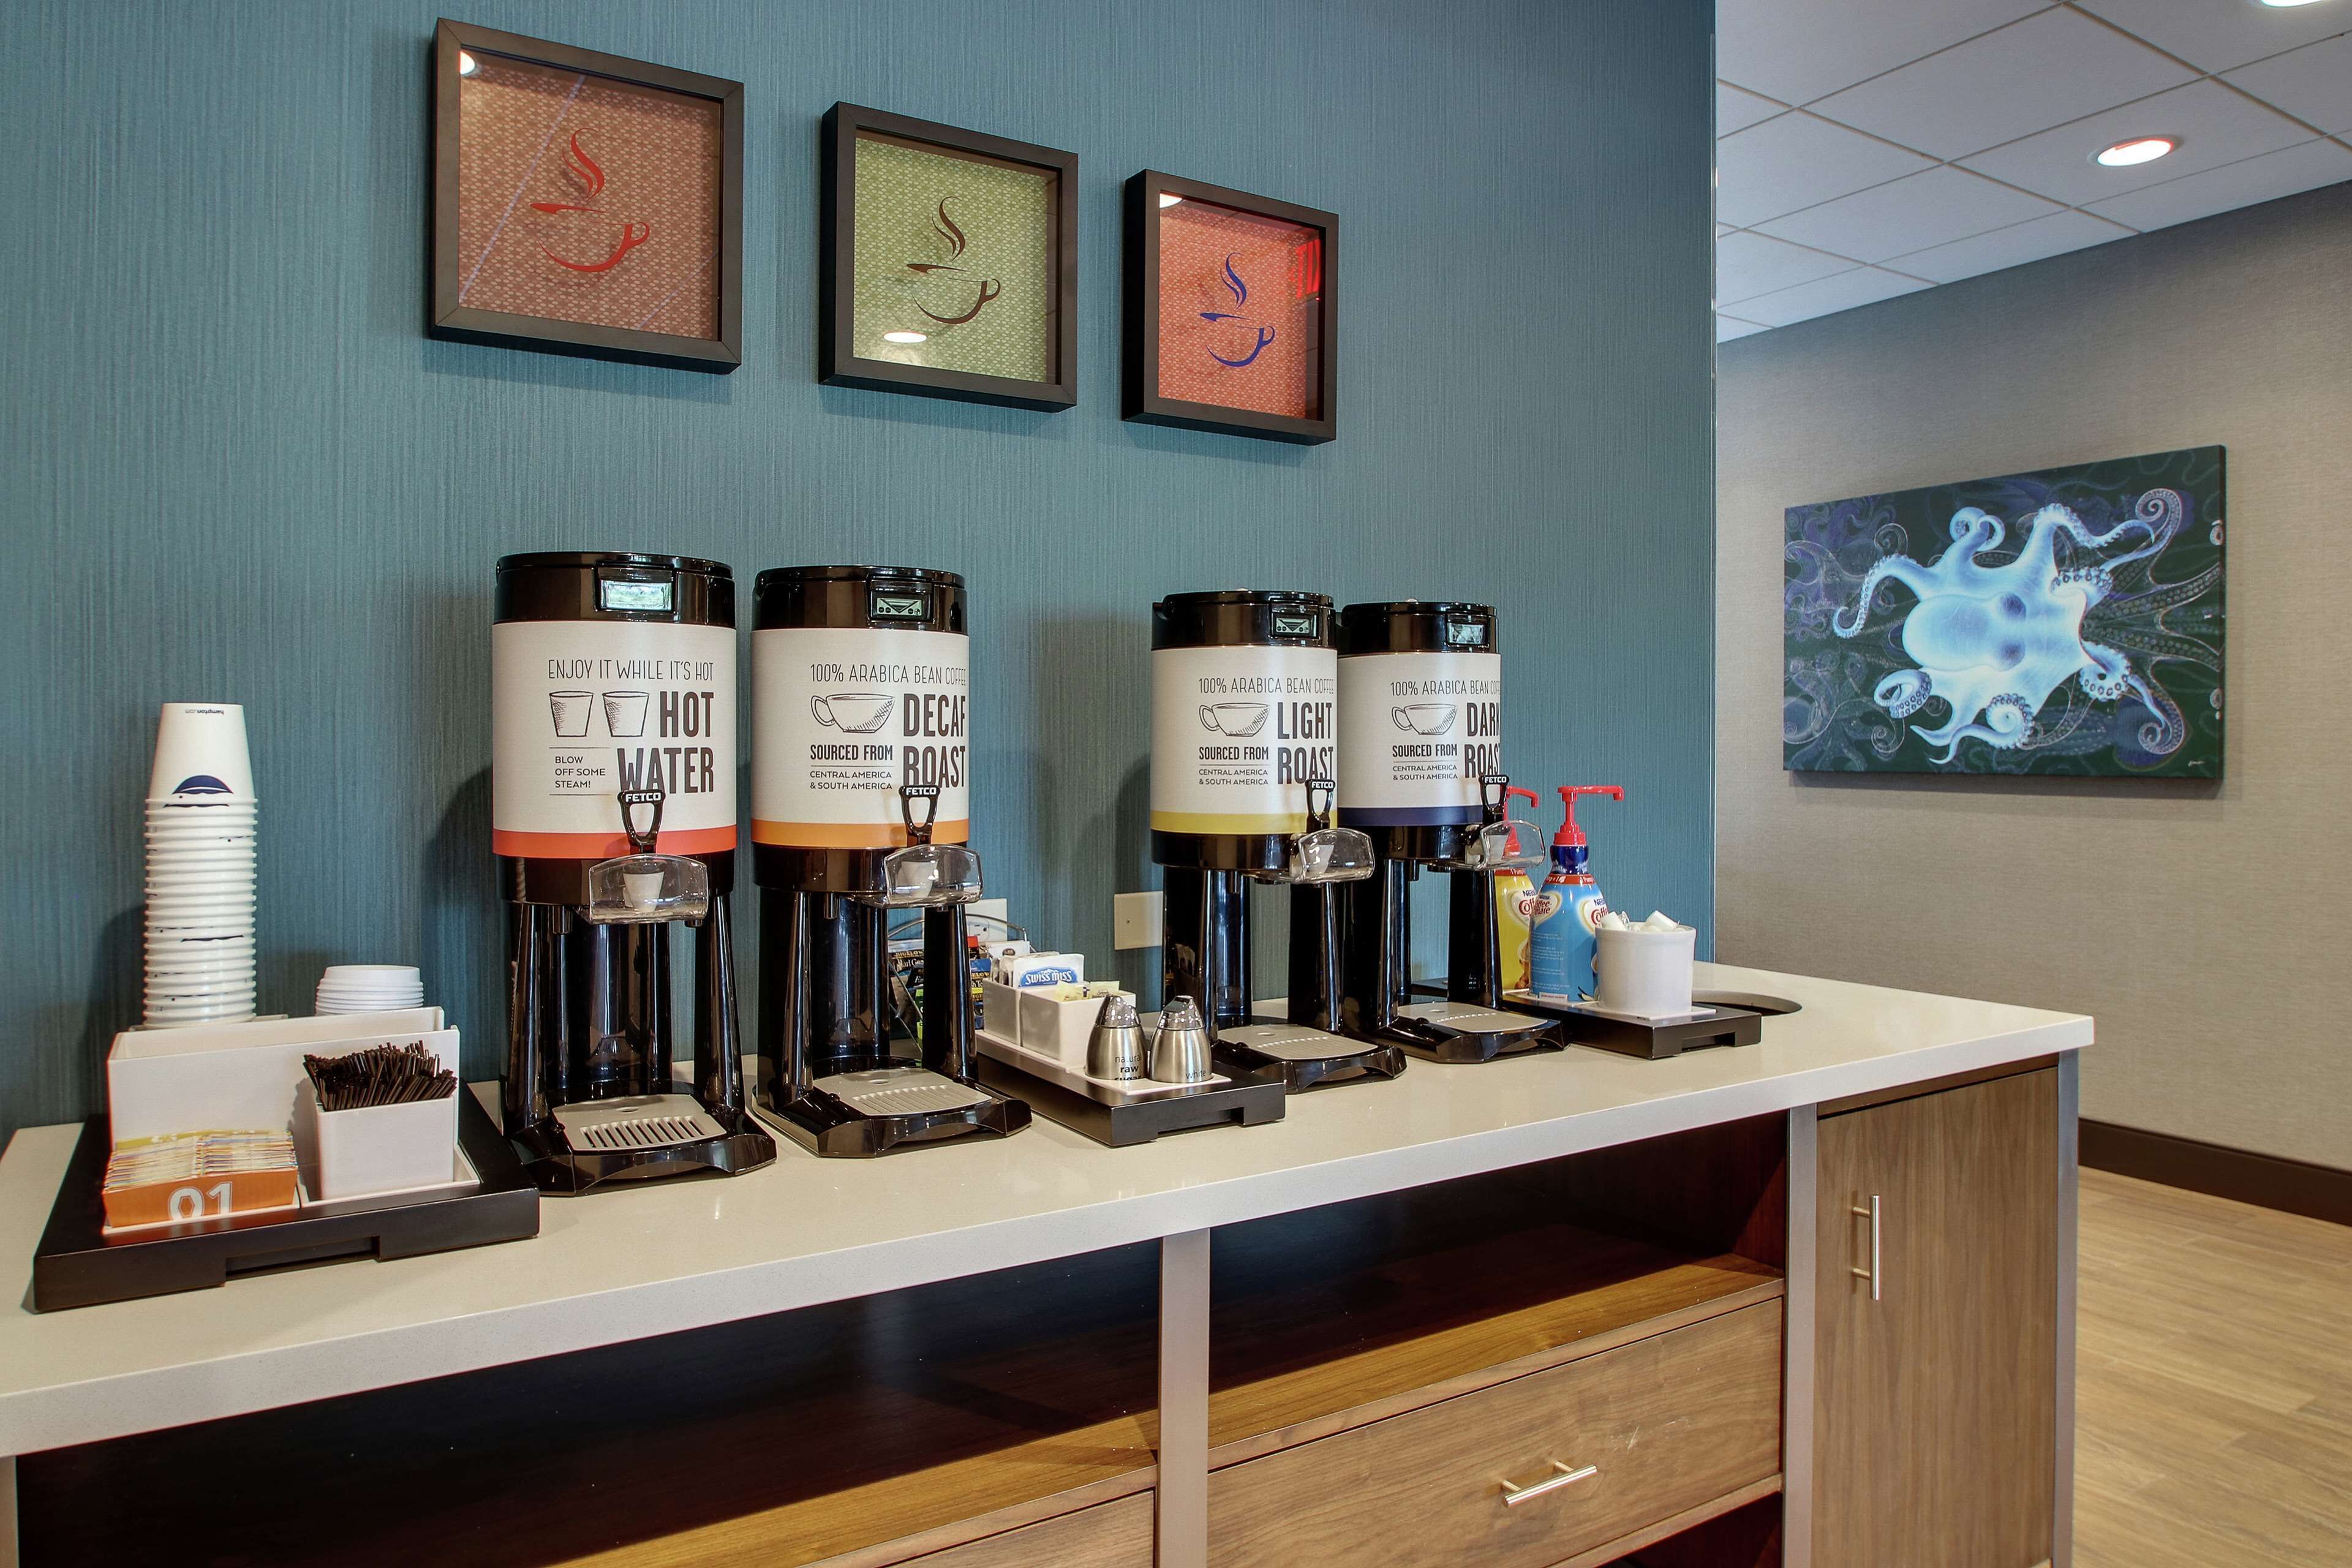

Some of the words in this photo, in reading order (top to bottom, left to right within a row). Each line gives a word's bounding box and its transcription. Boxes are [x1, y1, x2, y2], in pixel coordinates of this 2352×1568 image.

[549, 660, 592, 679] ENJOY
[600, 660, 611, 679] IT
[616, 660, 663, 679] WHILE
[671, 661, 690, 680] IT'S
[696, 662, 713, 681] HOT
[811, 664, 843, 682] 100%
[850, 665, 908, 682] ARABICA
[915, 666, 941, 684] BEAN
[1199, 677, 1226, 693] 100%
[1231, 677, 1281, 693] ARABICA
[1287, 678, 1311, 693] BEAN
[1390, 681, 1418, 696] 100%
[1422, 680, 1467, 695] ARABICA
[1471, 680, 1488, 694] BEAN
[660, 691, 714, 737] HOT
[903, 693, 965, 737] DECAF
[1278, 702, 1332, 739] LIGHT
[1466, 702, 1499, 737] DARK
[810, 745, 858, 760] SOURCED
[864, 745, 892, 760] FROM
[1199, 747, 1239, 760] SOURCED
[1244, 747, 1268, 760] FROM
[1392, 745, 1431, 757] SOURCED
[1436, 744, 1457, 756] FROM
[617, 747, 714, 794] WATER
[903, 745, 965, 788] ROAST
[1278, 746, 1333, 785] ROAST
[625, 793, 662, 802] FETCO
[906, 787, 937, 796] FETCO
[1186, 1069, 1206, 1079] white
[167, 1181, 233, 1219] 01
